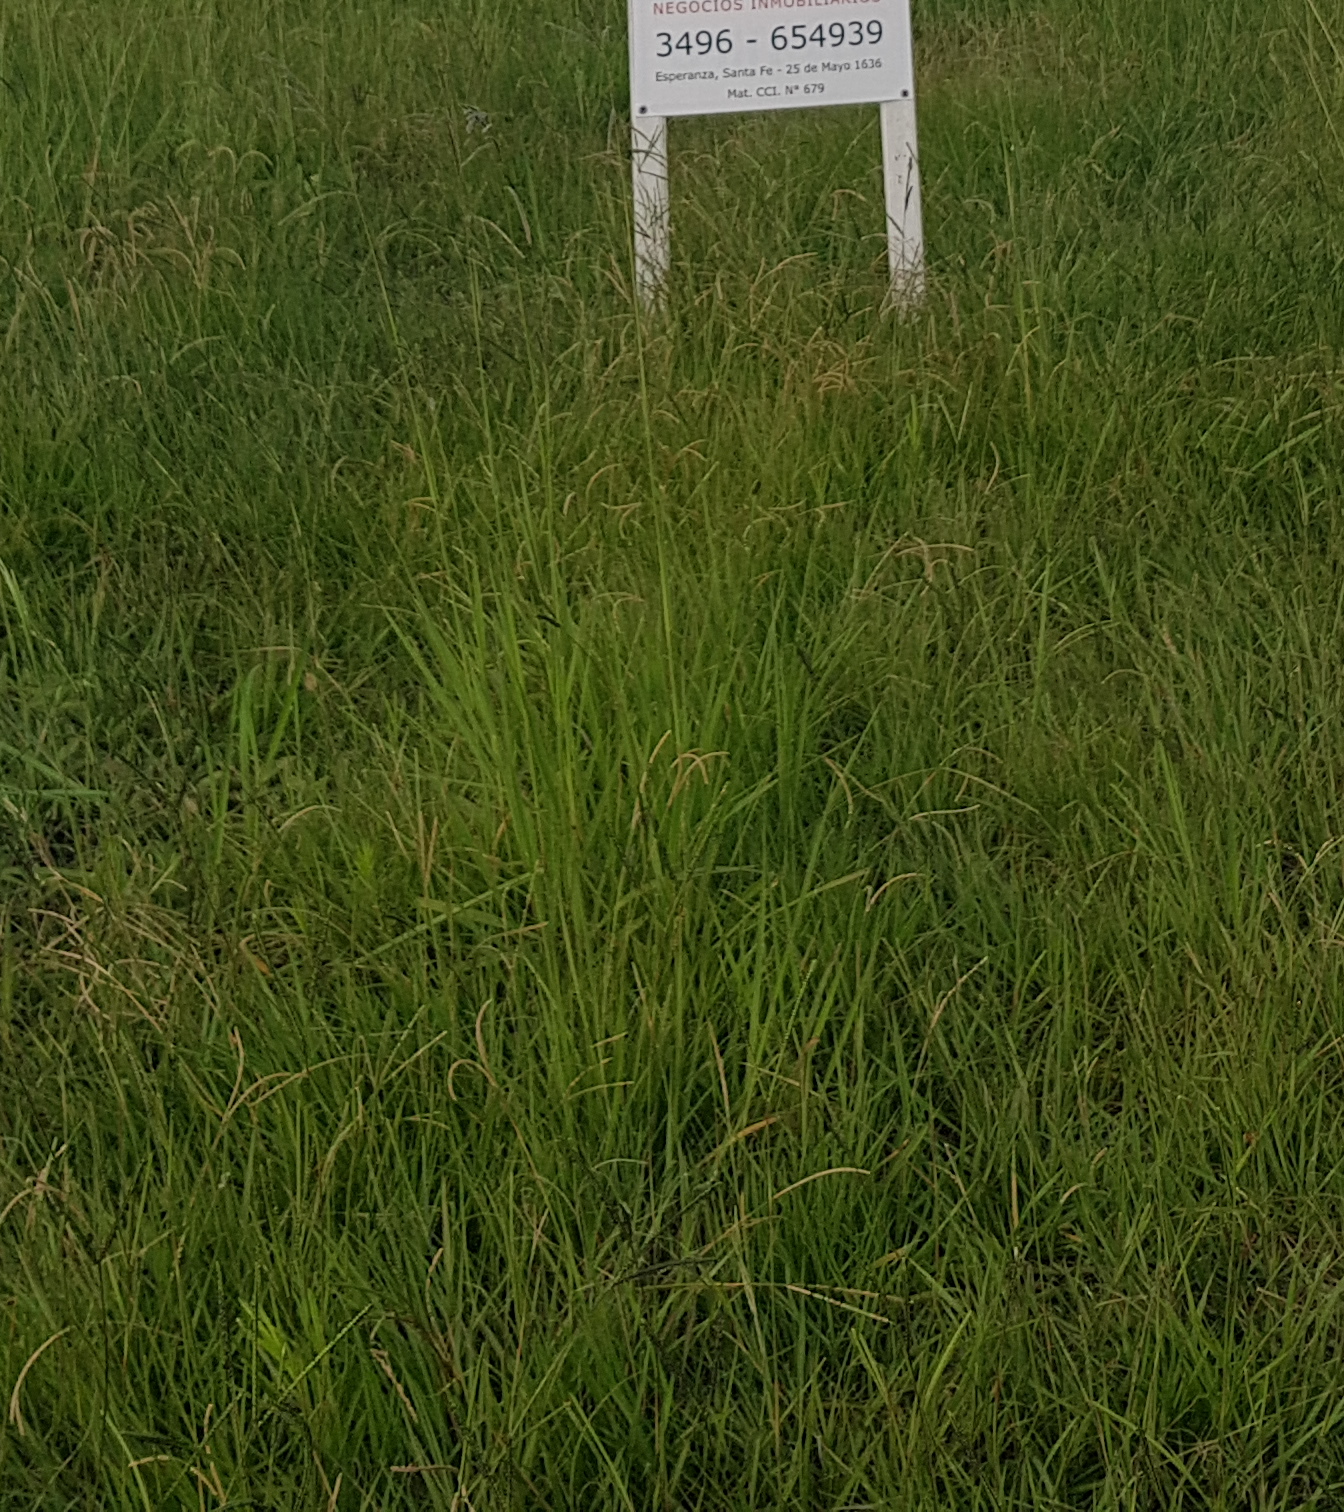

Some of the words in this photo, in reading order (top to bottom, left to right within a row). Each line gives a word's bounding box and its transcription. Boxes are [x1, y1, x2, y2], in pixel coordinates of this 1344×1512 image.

[656, 29, 733, 57] 3496
[771, 20, 883, 50] 654939
[656, 70, 718, 83] Esperanza,
[723, 67, 756, 78] Santa
[760, 66, 773, 76] Fe
[786, 65, 800, 74] 25
[804, 63, 818, 73] de
[822, 61, 850, 74] Mayo
[855, 59, 882, 69] 1636
[727, 88, 752, 99] Mat.
[803, 84, 825, 94] 679
